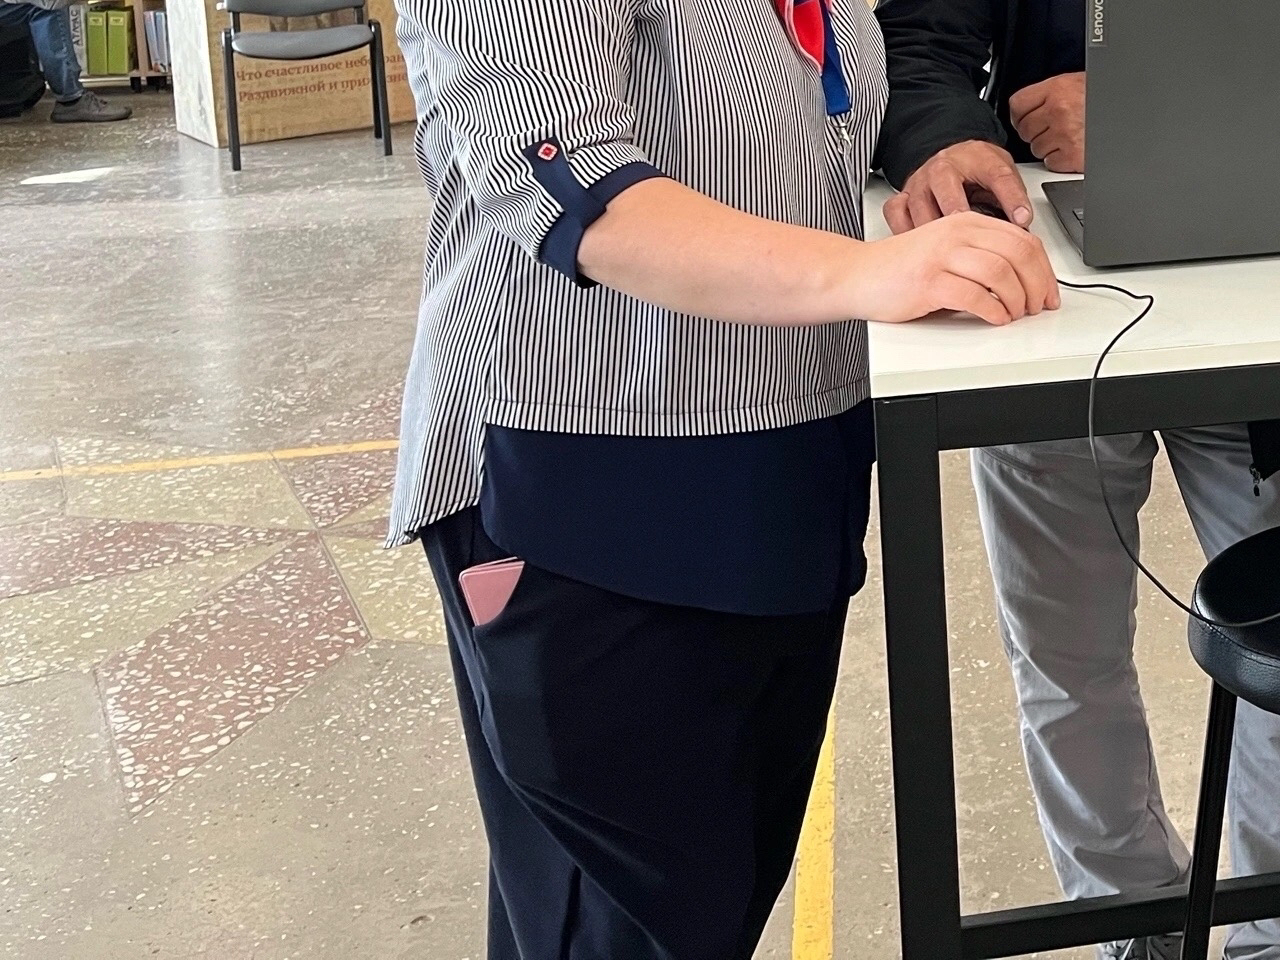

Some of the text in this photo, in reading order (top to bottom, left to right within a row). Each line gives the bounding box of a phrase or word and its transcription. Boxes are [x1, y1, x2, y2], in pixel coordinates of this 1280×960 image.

[236, 69, 262, 83] Что
[264, 60, 342, 79] счастливое
[238, 81, 326, 102] Раздвижной
[328, 81, 338, 91] и
